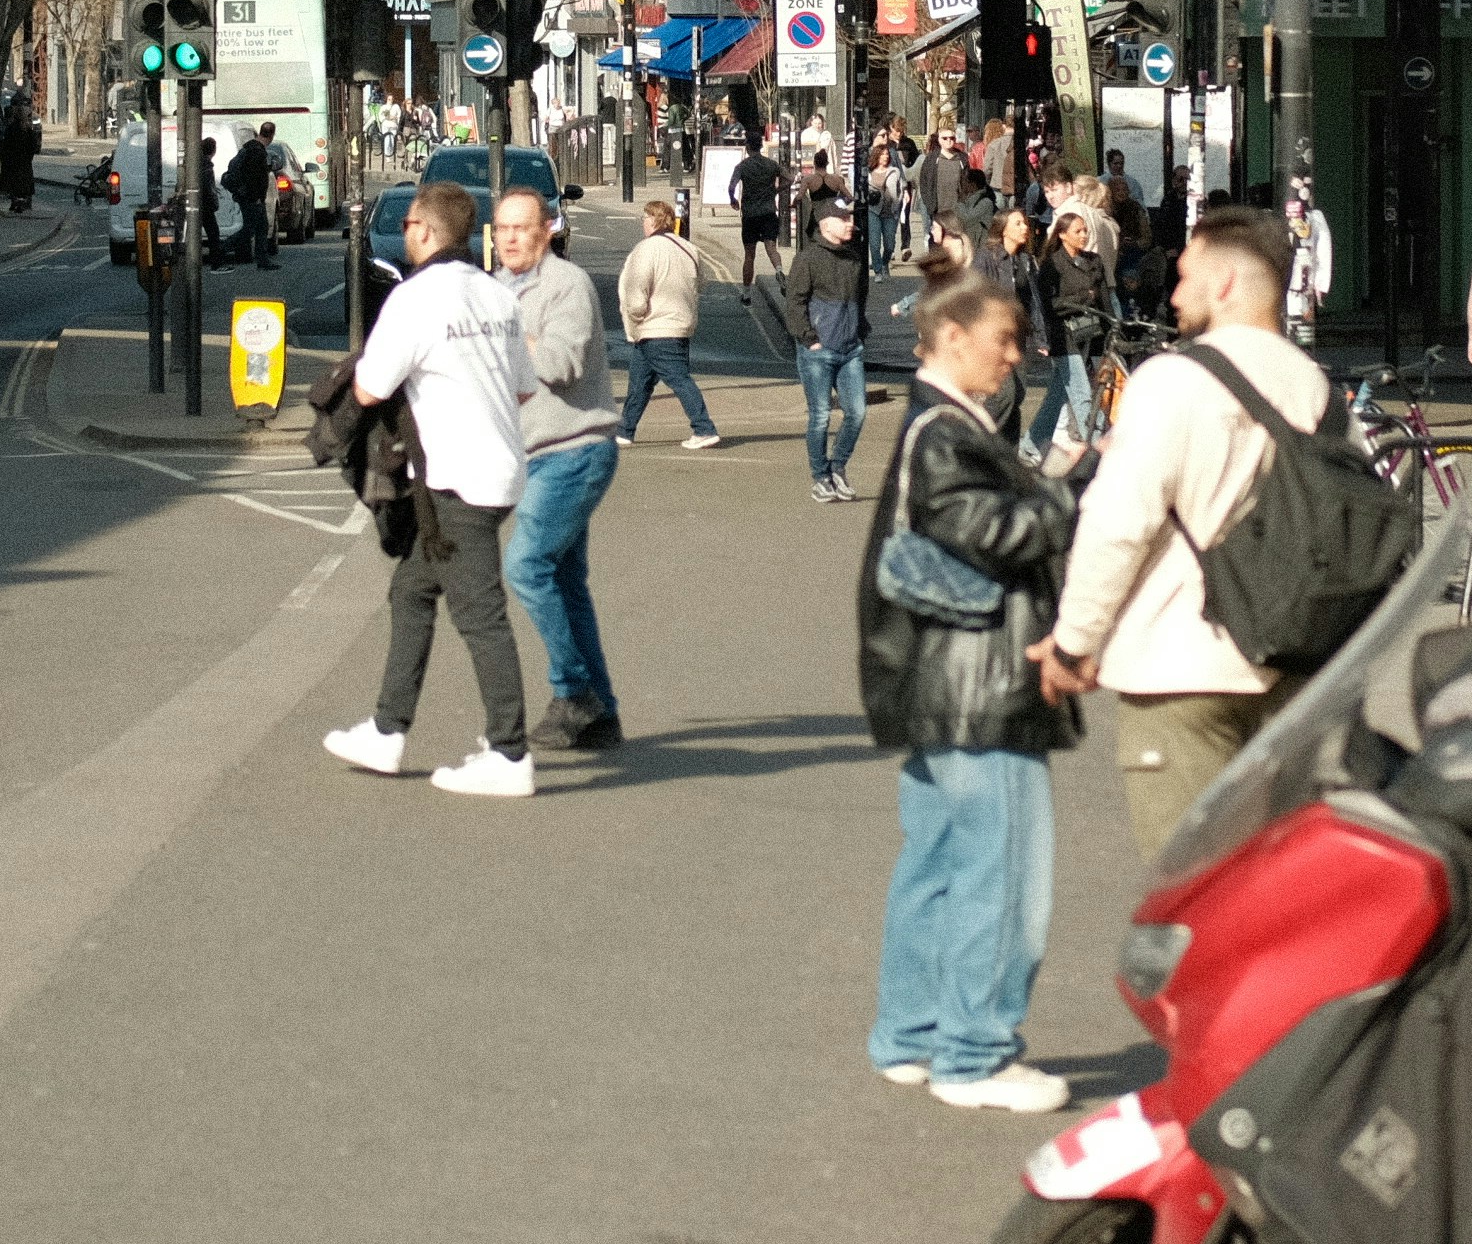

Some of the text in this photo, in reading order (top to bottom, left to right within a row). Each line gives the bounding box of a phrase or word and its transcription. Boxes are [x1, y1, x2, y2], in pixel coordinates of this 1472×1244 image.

[231, 2, 250, 21] 31
[217, 27, 294, 38] ntire bus fleet
[217, 38, 240, 47] 00%
[244, 38, 264, 47] low
[216, 48, 278, 57] o-emission
